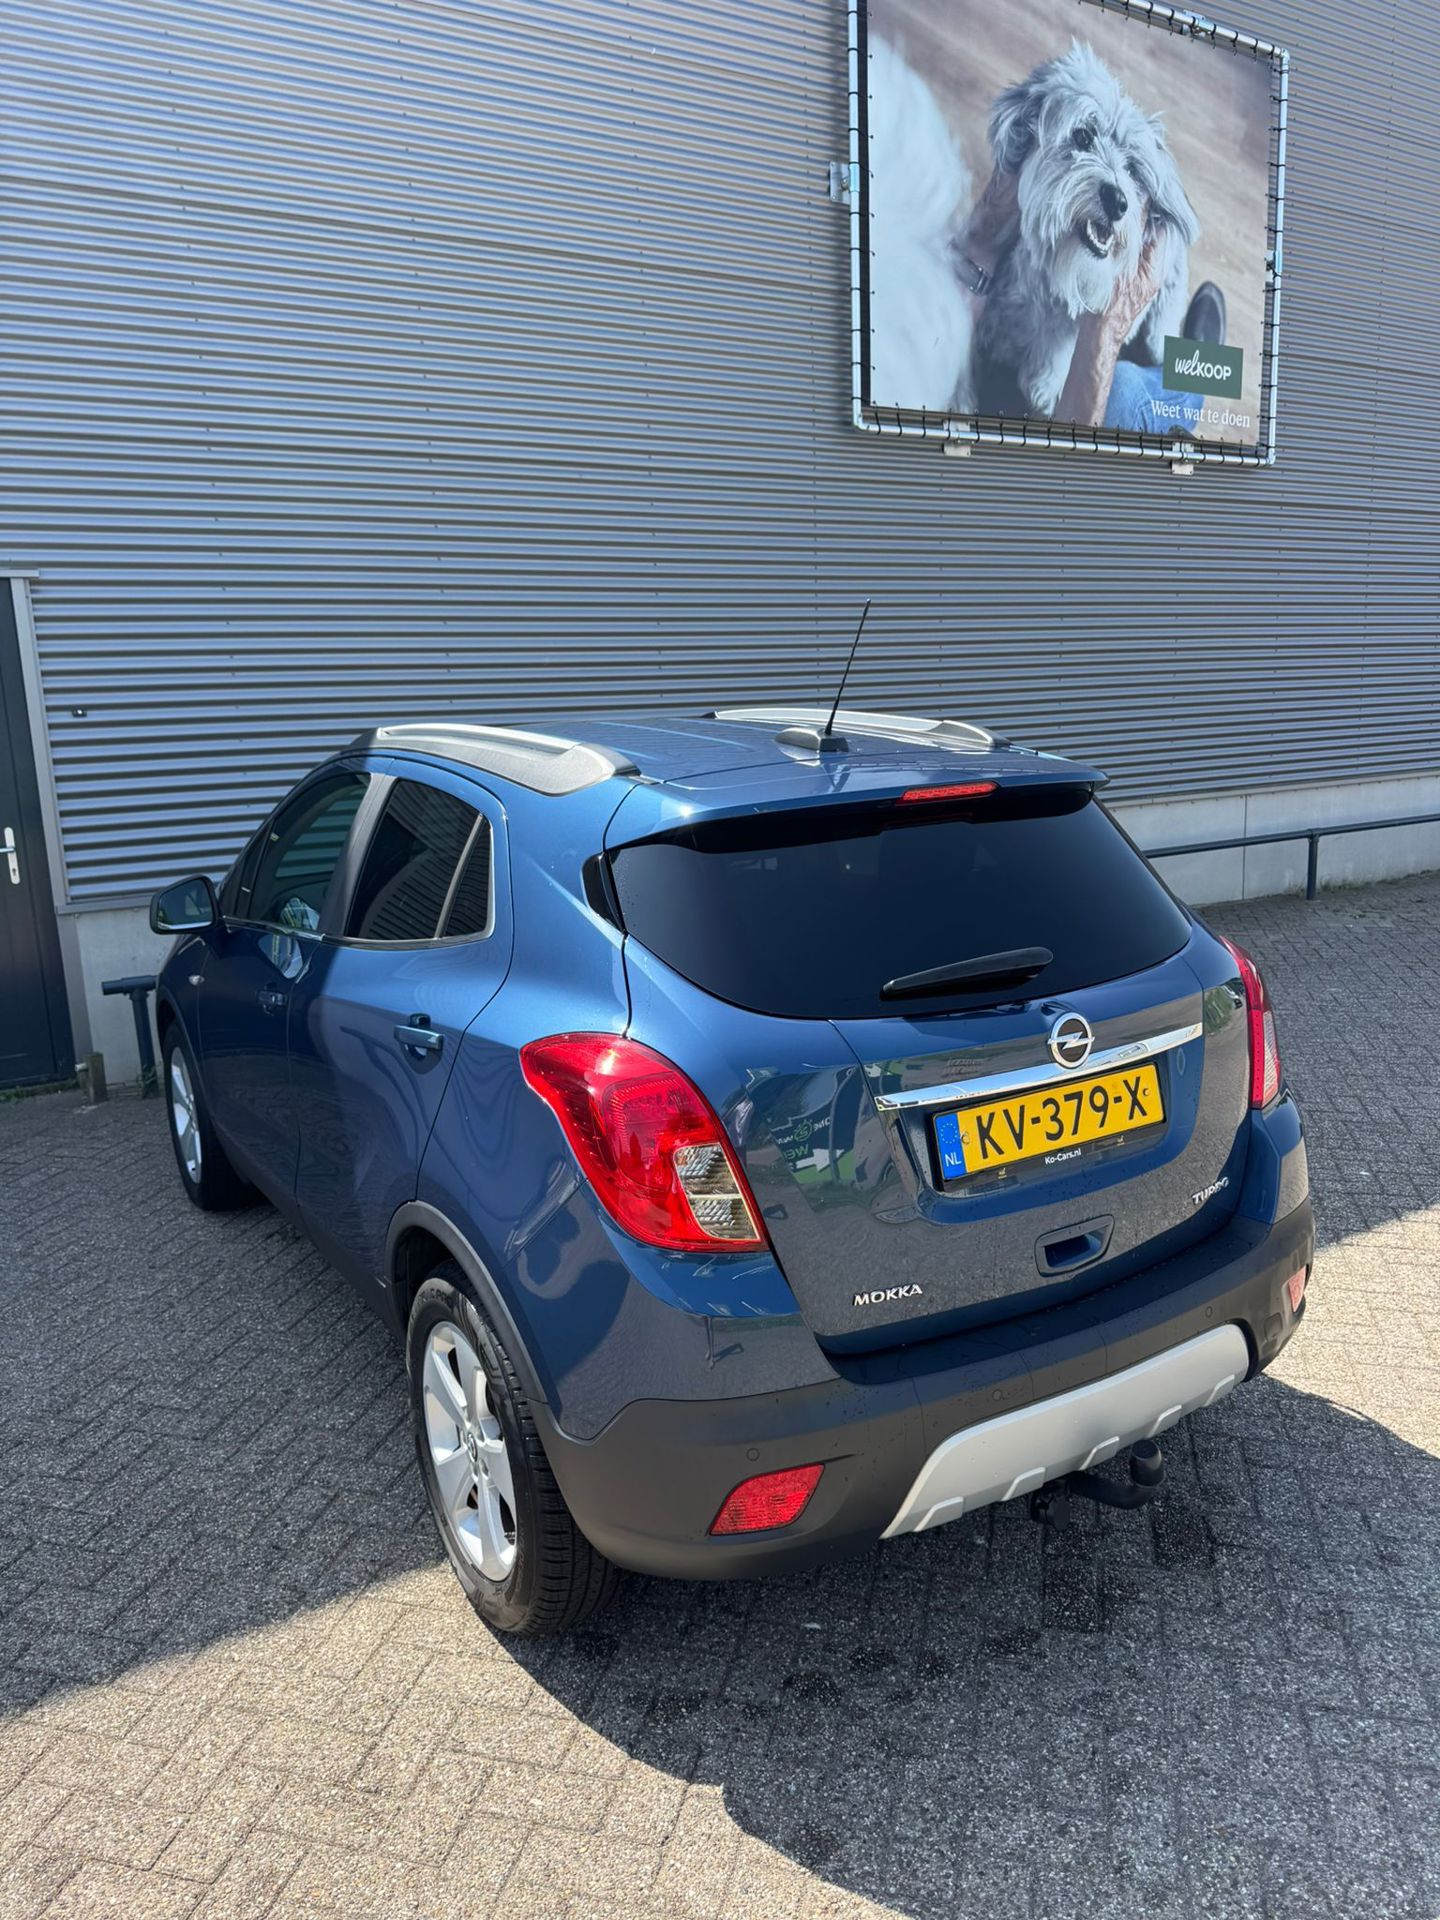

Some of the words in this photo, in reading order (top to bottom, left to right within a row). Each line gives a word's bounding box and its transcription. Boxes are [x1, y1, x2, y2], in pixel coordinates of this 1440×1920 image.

[1150, 400, 1182, 419] Weet
[1183, 407, 1205, 421] wat
[1207, 408, 1220, 424] te
[1221, 409, 1251, 428] doen
[975, 1075, 1148, 1161] KV-379-X
[944, 1151, 962, 1168] NL
[1044, 1147, 1082, 1165] Ko-Cars.nl
[1191, 1176, 1229, 1205] TURBO
[853, 1283, 923, 1307] MOKKA
